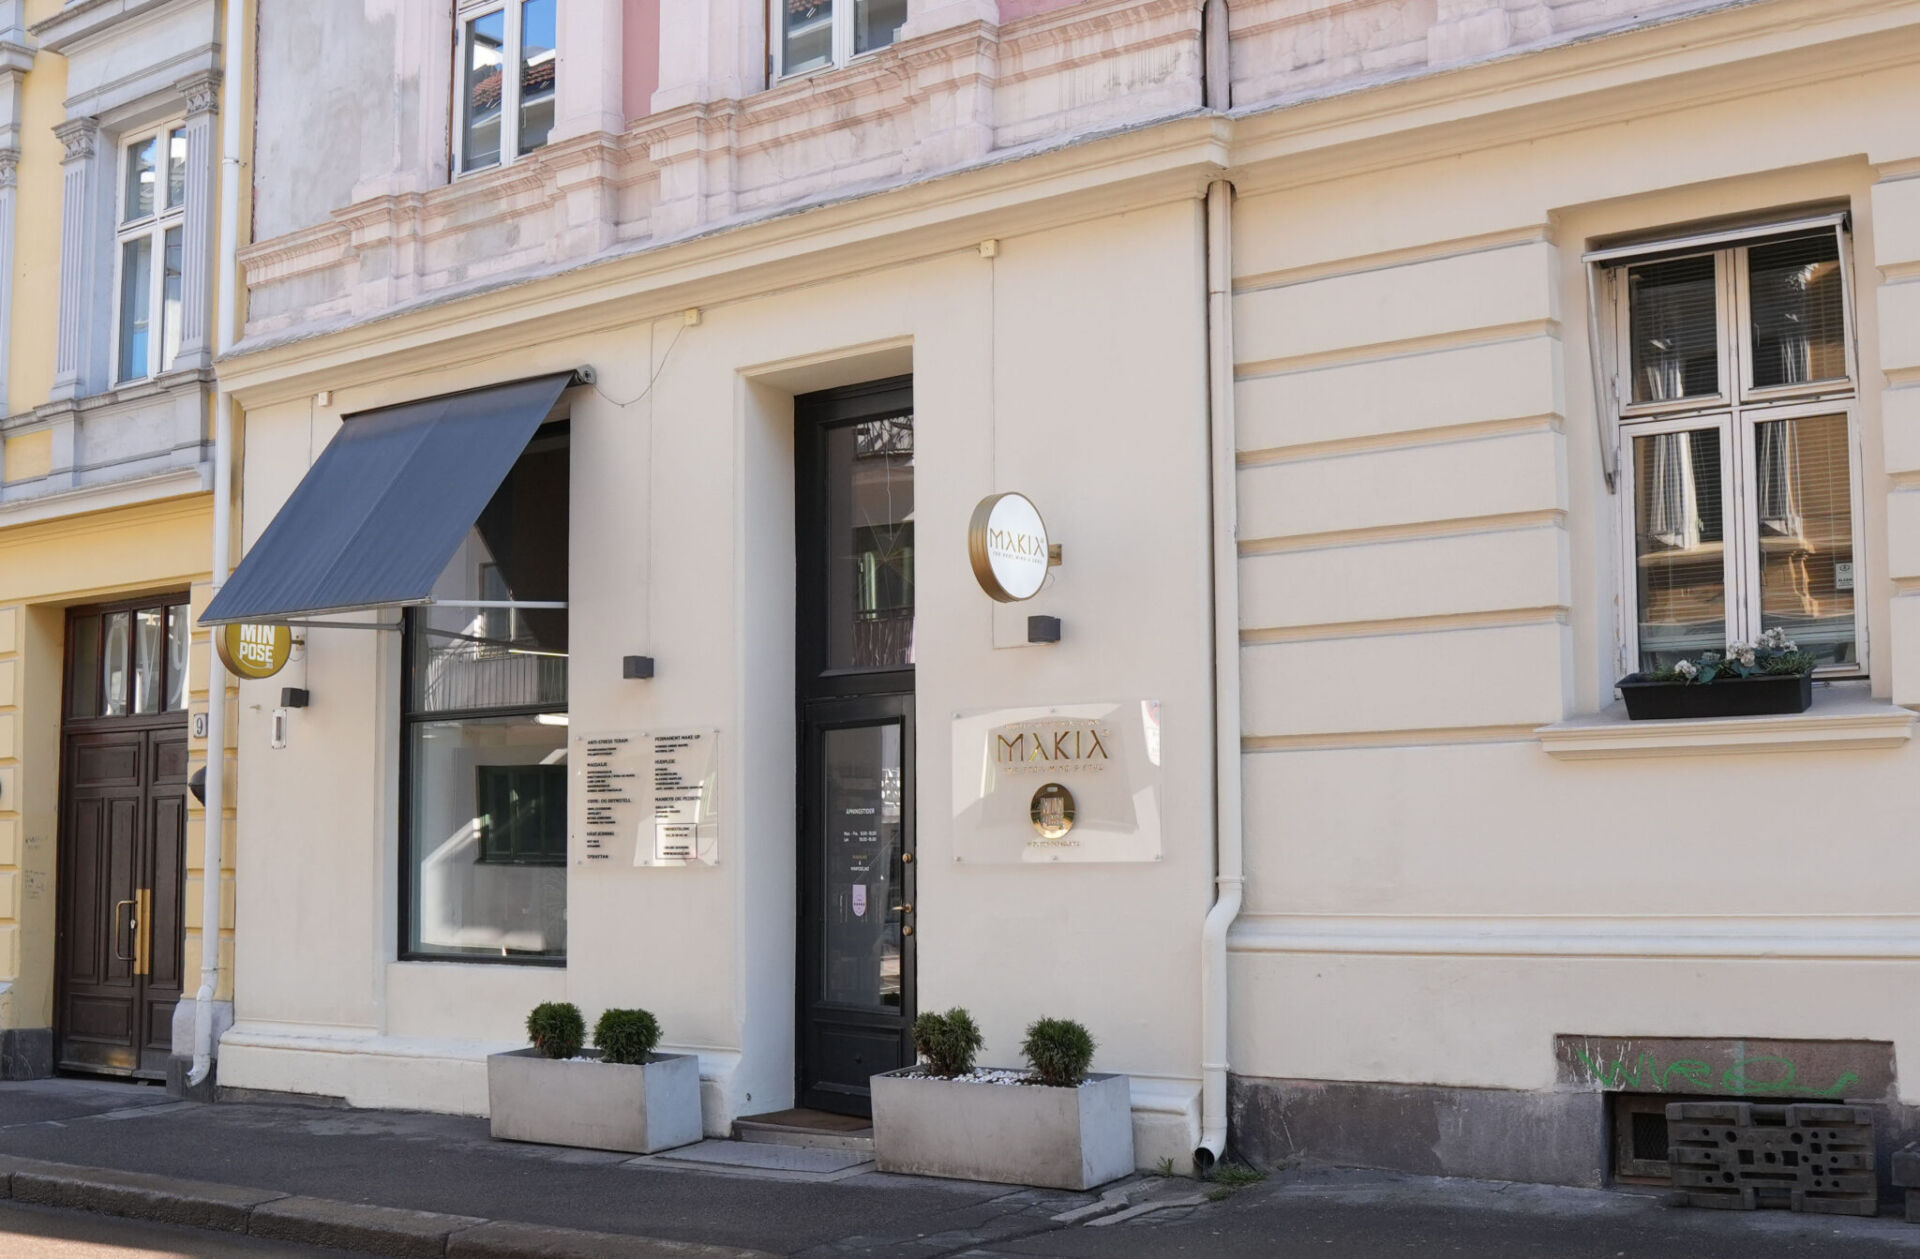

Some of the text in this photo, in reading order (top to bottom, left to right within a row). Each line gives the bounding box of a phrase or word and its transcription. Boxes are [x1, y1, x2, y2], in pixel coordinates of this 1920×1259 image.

[990, 527, 1045, 558] MAKIA
[241, 624, 275, 645] MIN
[240, 642, 273, 663] POSE
[196, 717, 204, 735] 9
[997, 729, 1108, 763] MAKIA
